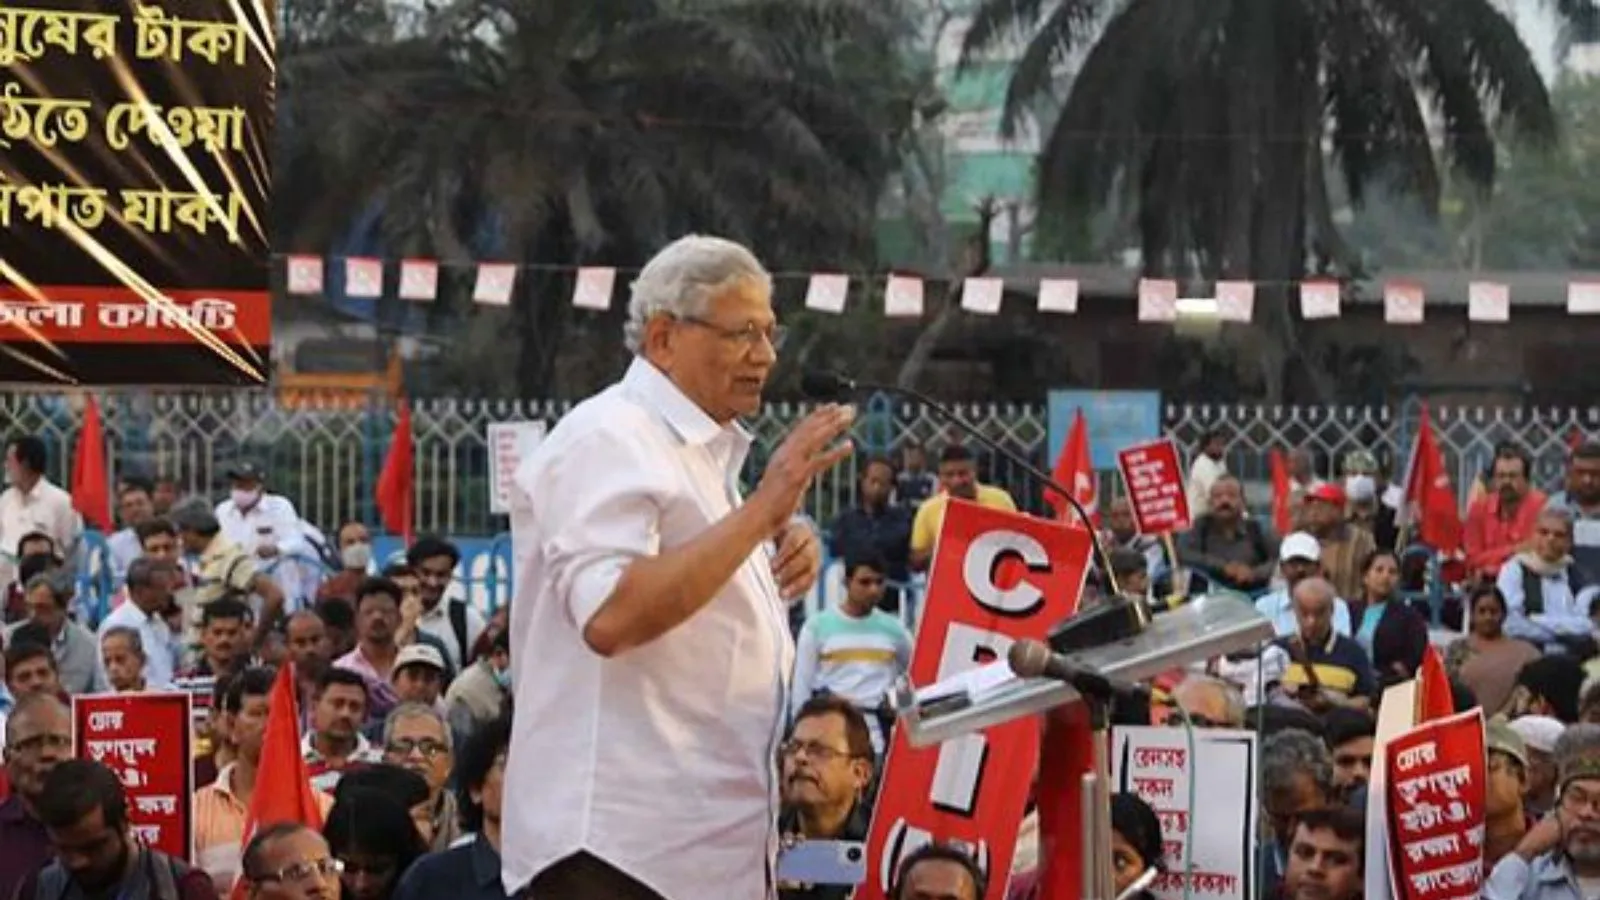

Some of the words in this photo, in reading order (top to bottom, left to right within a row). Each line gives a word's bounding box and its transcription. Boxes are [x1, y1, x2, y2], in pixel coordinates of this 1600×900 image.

[135, 4, 247, 65] টাকা
[106, 102, 246, 151] দেওয়া
[98, 297, 237, 331] কমিটি
[88, 711, 124, 732] চোর
[1396, 741, 1437, 773] চোর
[1396, 764, 1471, 804] তৃণমূল
